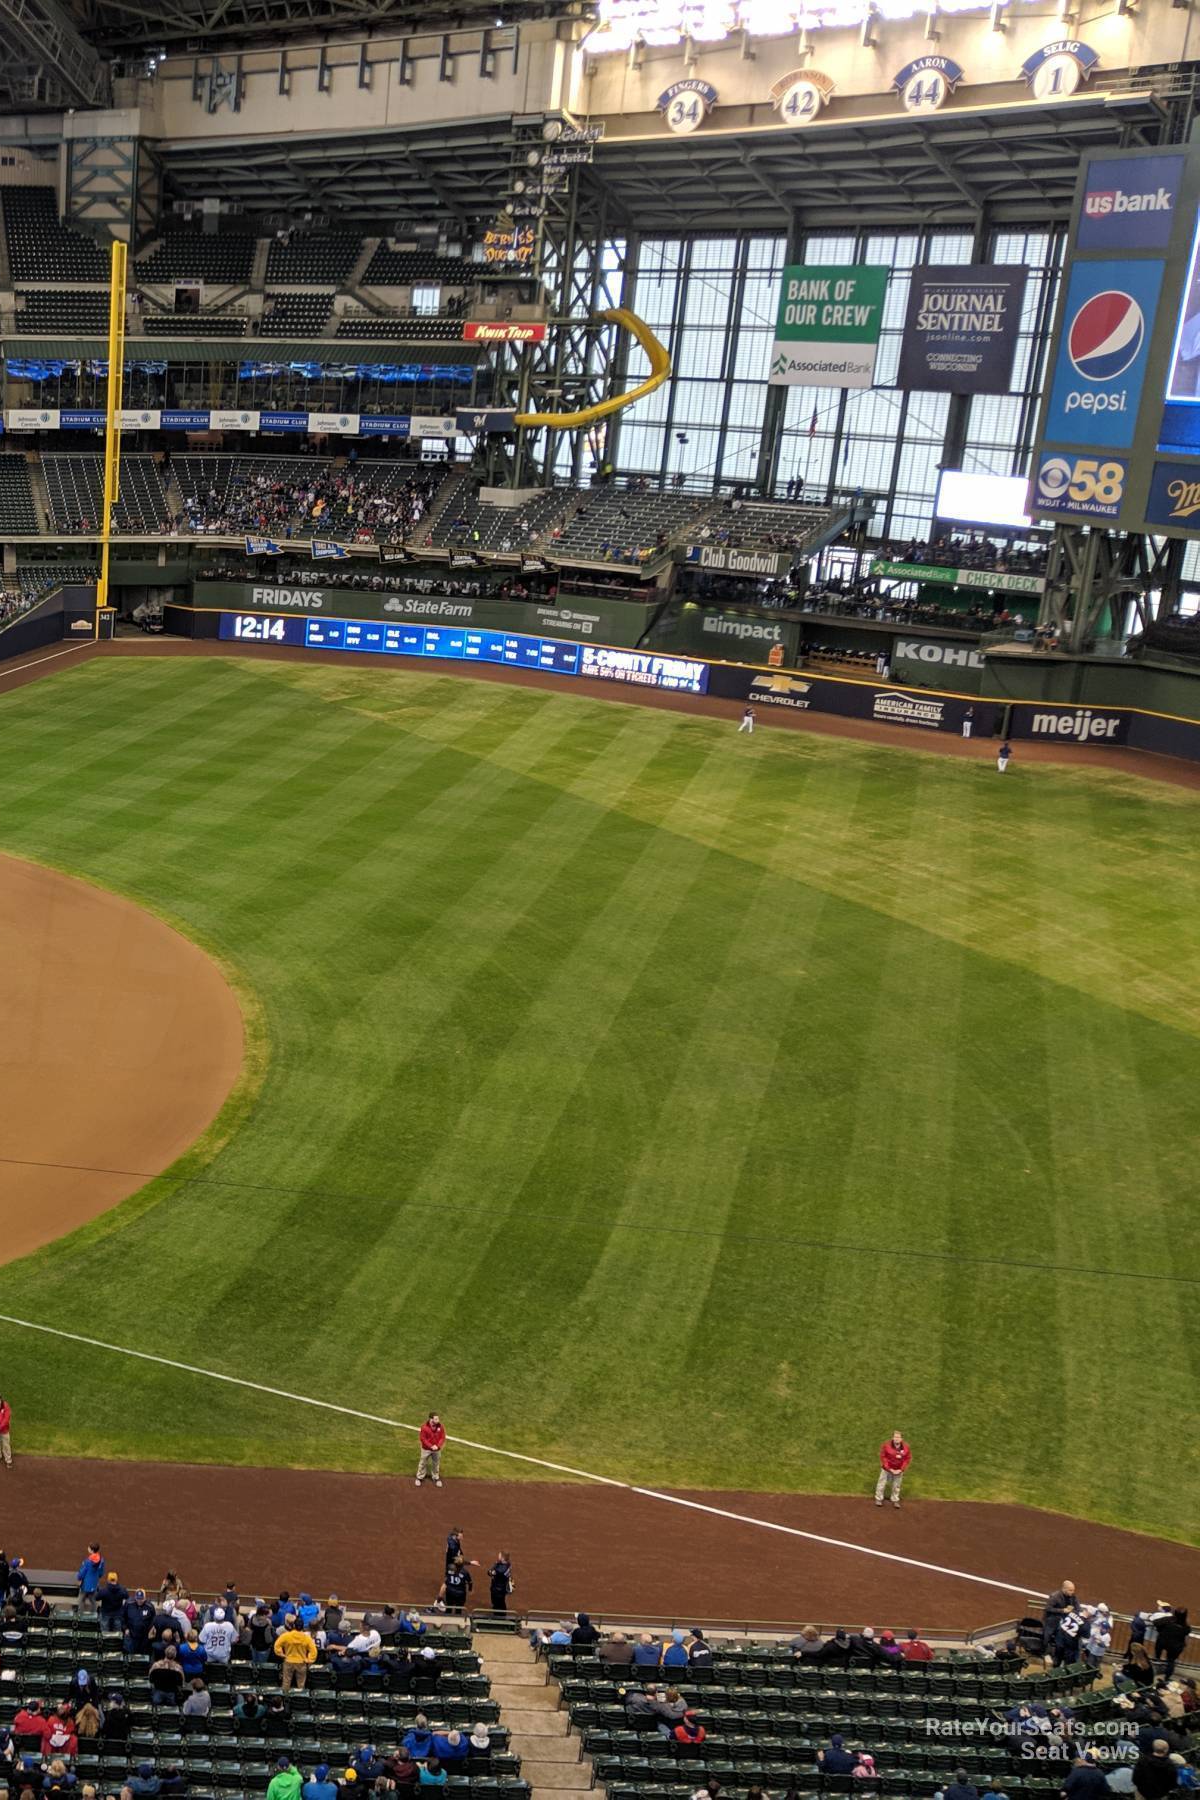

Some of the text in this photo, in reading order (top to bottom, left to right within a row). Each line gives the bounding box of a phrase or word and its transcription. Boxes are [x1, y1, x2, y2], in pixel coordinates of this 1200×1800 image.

[1043, 40, 1079, 57] SELIG
[910, 57, 948, 73] AARON
[668, 81, 710, 98] FINGERS
[1048, 67, 1063, 94] 1
[785, 91, 814, 115] 42
[908, 78, 941, 107] 44
[670, 100, 700, 125] 34
[788, 280, 856, 301] BANK OF
[918, 294, 1007, 313] JOURNAL
[784, 305, 870, 327] OUR CREW
[916, 313, 1004, 332] SENTINEL
[926, 332, 991, 342] jsonline.com
[1065, 390, 1127, 415] pepsi
[1069, 460, 1124, 504] 58
[1067, 501, 1118, 514] MILWAUKEE
[701, 546, 779, 574] Club Goodwill
[967, 572, 1039, 591] CHECK DECK
[253, 588, 324, 608] FRIDAYS
[235, 615, 285, 641] 12:14
[717, 615, 782, 641] impact
[583, 647, 705, 681] 5-COUNTY FRIDAY
[896, 641, 985, 668] KOHL
[749, 692, 811, 709] CHEVROLET
[875, 698, 942, 713] AMERICAN FAMILY
[1032, 710, 1120, 742] meijer
[211, 1636, 225, 1646] 22
